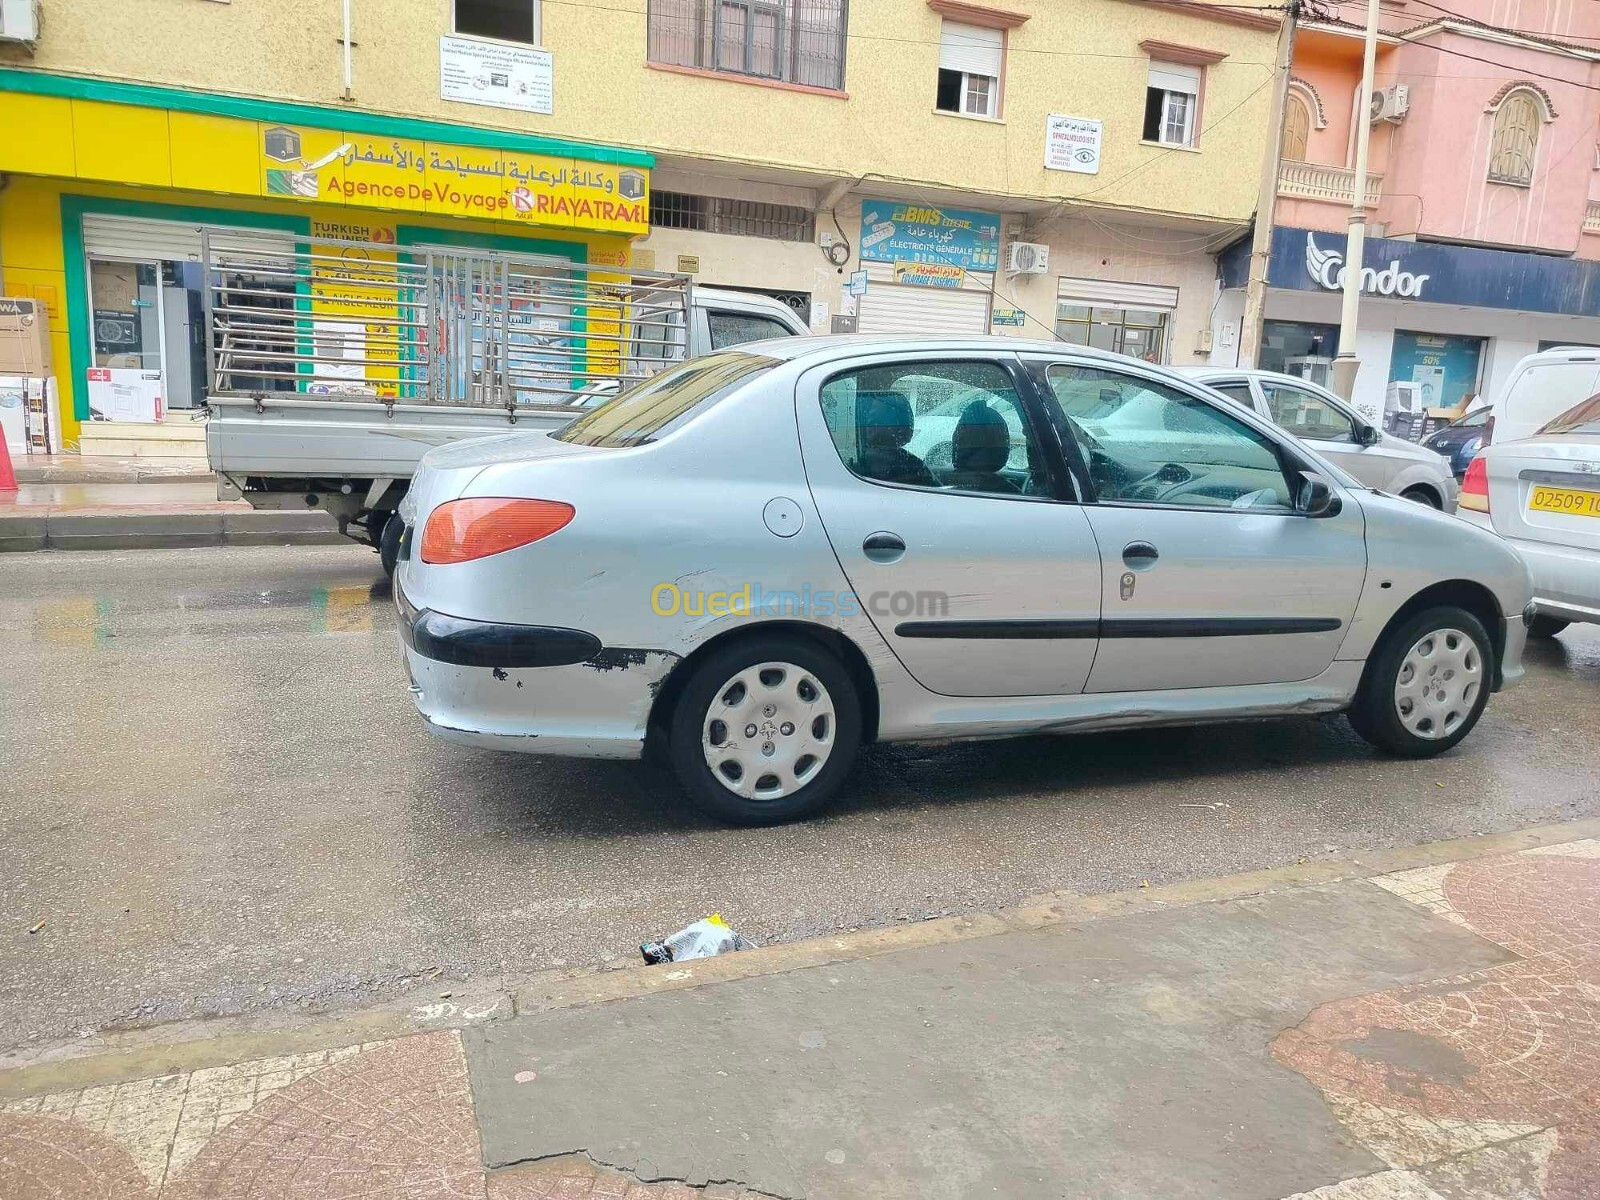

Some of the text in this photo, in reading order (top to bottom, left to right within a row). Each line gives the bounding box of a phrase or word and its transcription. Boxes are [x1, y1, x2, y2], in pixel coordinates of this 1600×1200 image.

[430, 151, 506, 178] للسياحة
[508, 161, 567, 187] الرعاية
[570, 168, 614, 194] وكالة
[313, 221, 370, 236] TURKISH
[906, 225, 957, 243] كهرباء عامة
[935, 243, 973, 256] GÉNÉRALE
[1422, 355, 1440, 366] 50%
[1535, 491, 1585, 510] 02509
